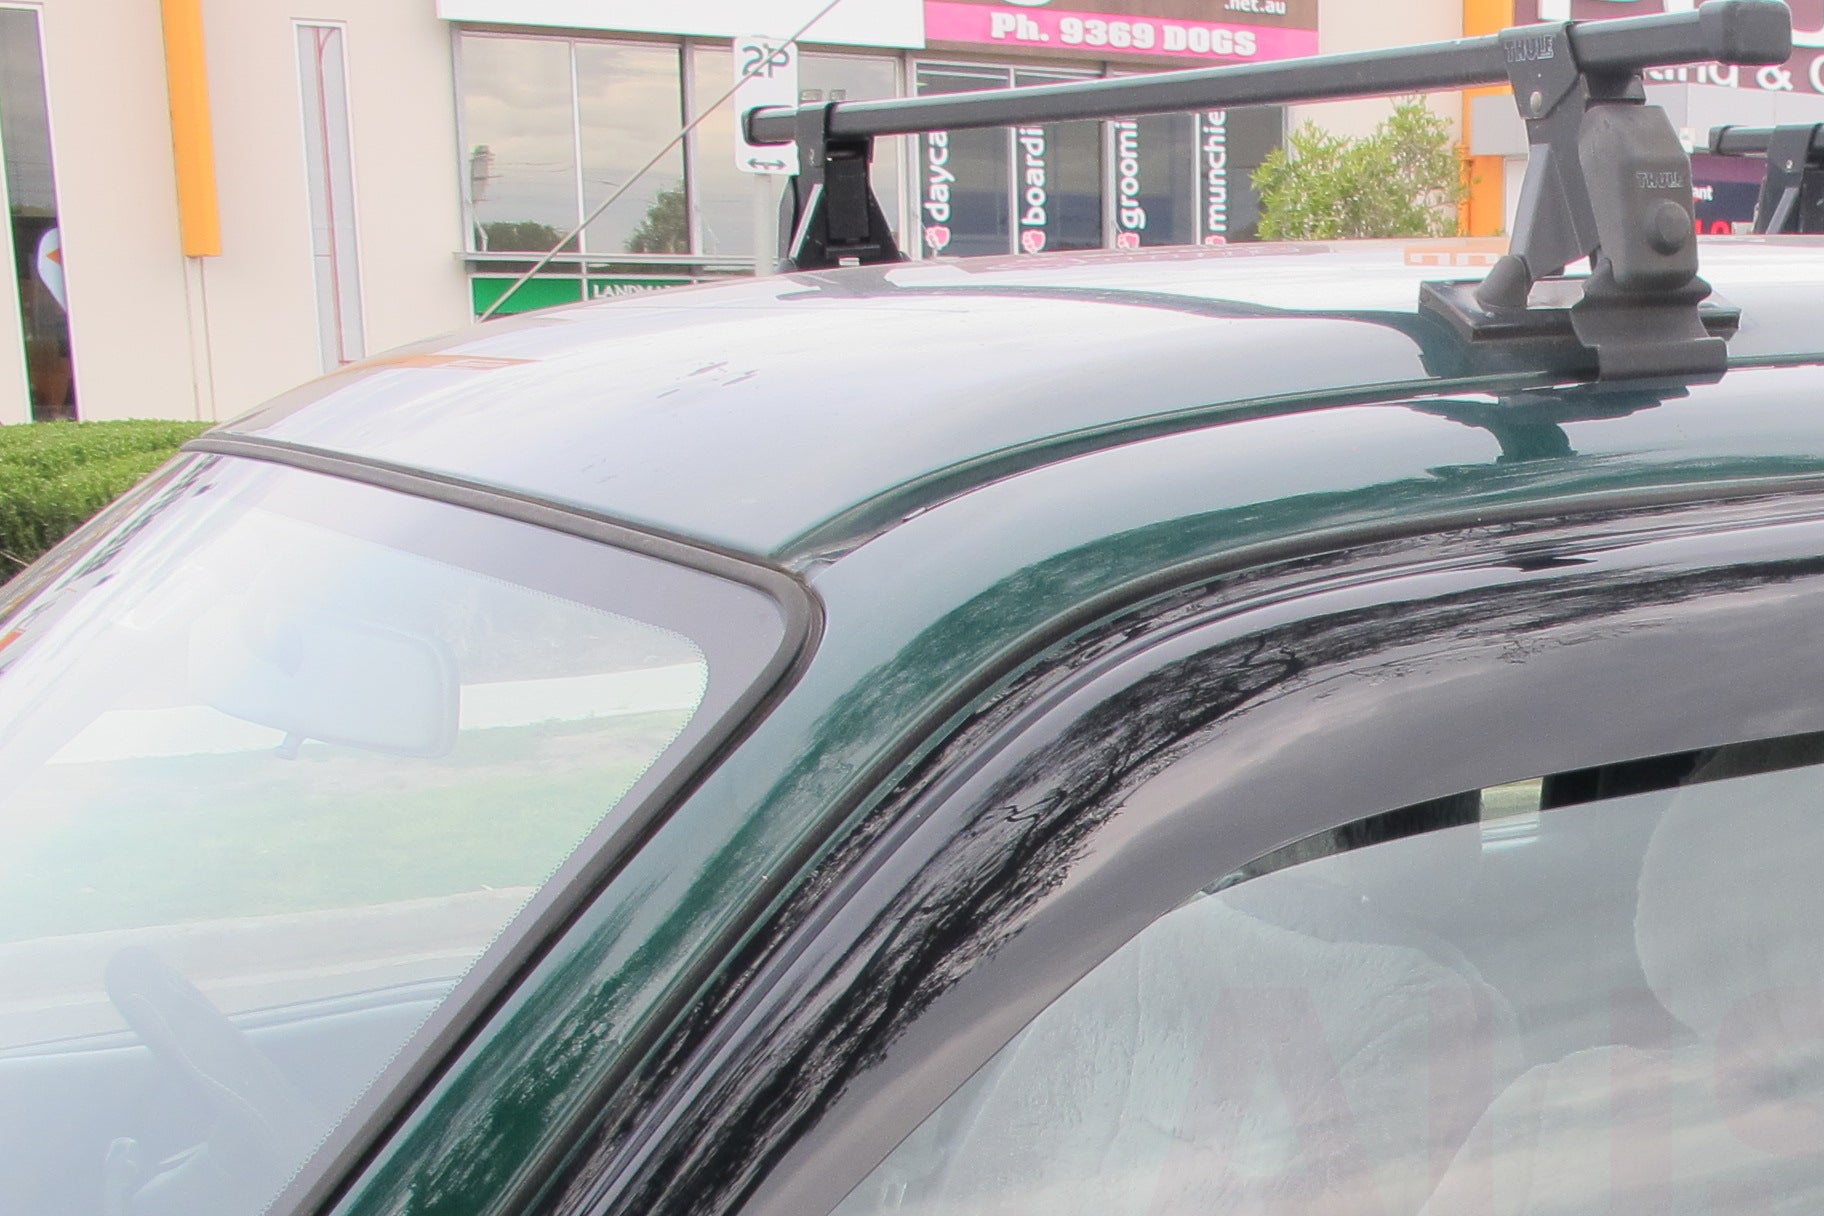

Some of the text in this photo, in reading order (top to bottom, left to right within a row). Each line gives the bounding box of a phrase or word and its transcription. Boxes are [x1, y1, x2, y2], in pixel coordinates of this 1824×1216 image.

[990, 12, 1258, 56] Ph. 9369 DOGS
[1504, 35, 1555, 62] THULE
[742, 45, 790, 78] 2P
[1756, 64, 1793, 91] &
